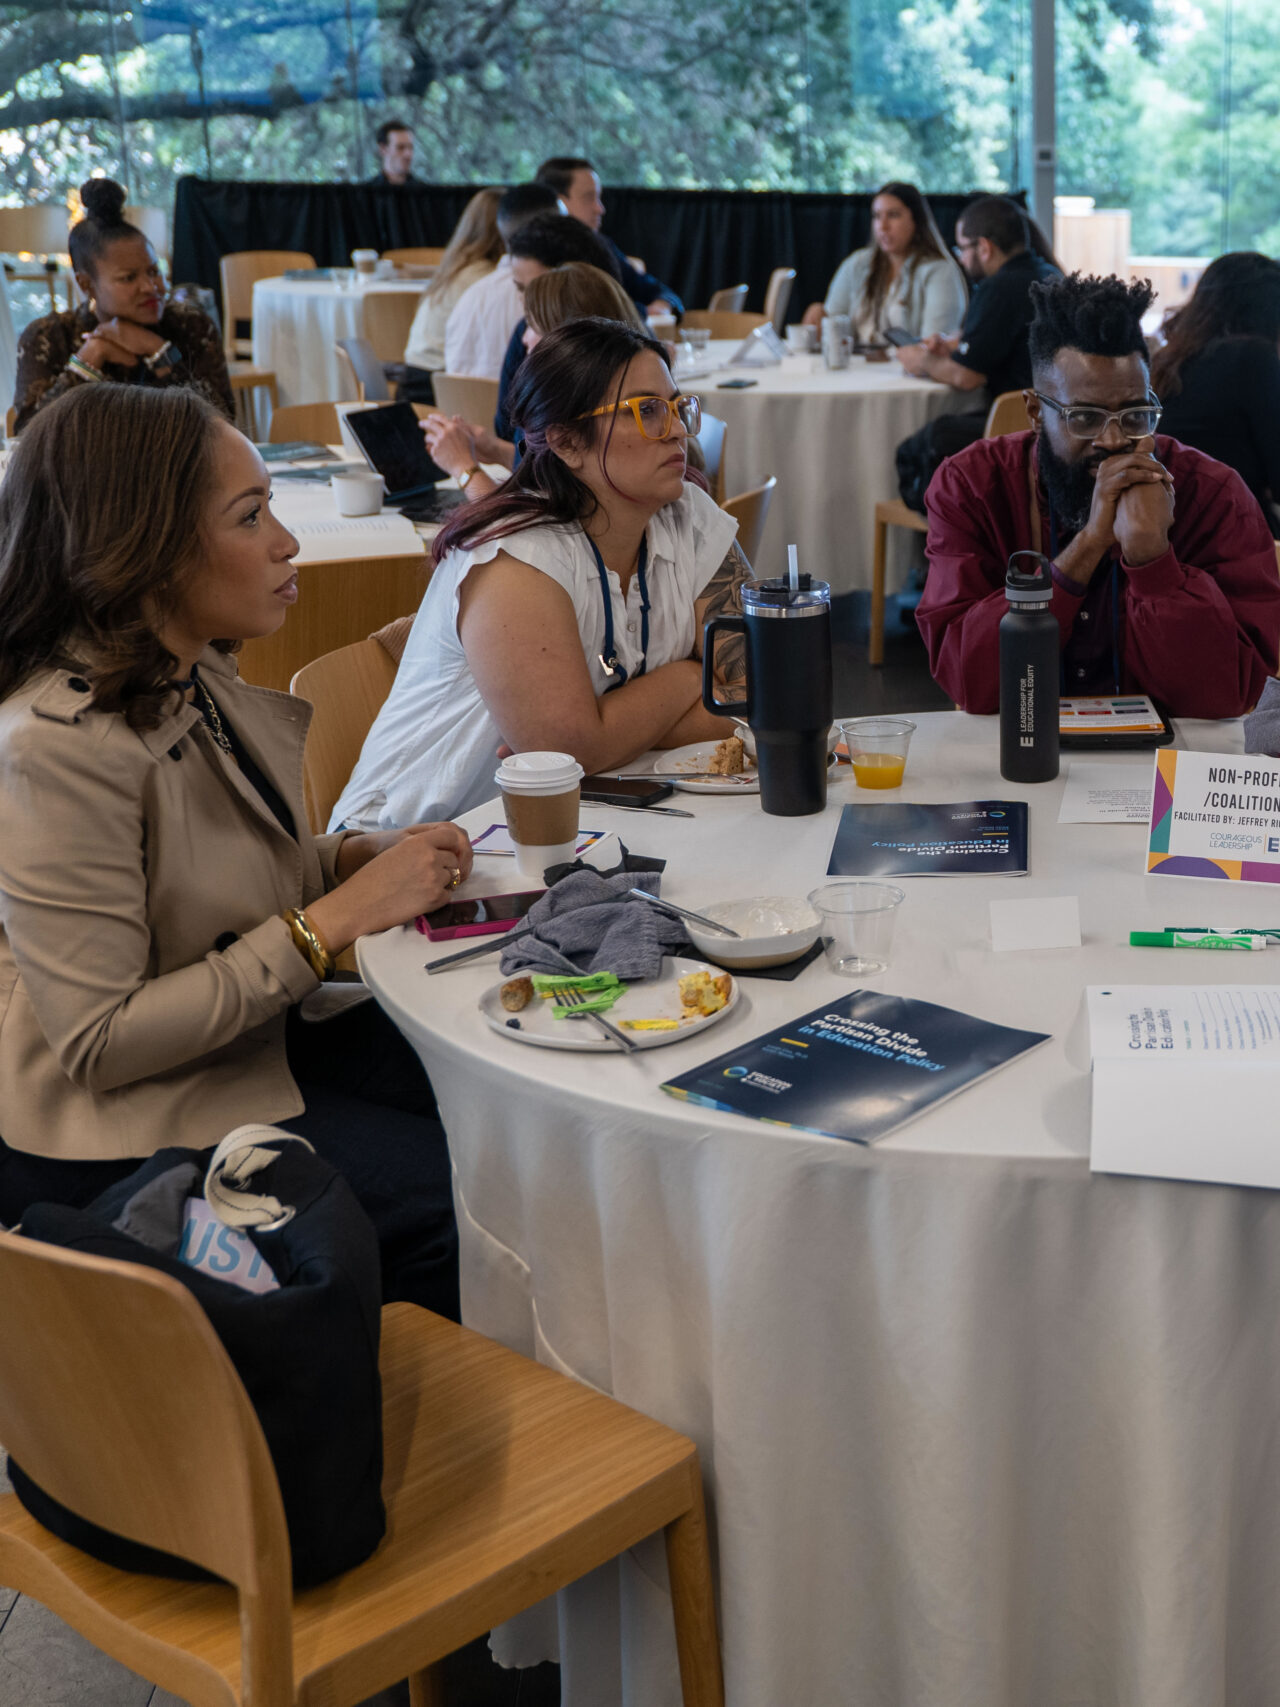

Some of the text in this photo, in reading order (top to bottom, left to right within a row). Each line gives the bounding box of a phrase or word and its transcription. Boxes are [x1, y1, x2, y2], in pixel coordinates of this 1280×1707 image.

[1174, 811, 1221, 824] FACILITATED
[1223, 815, 1235, 825] BY:
[1238, 816, 1269, 827] JEFFREY
[919, 839, 992, 847] Education
[1209, 840, 1253, 851] LEADERSHIP
[1210, 832, 1263, 844] COURAGEOUS
[824, 1013, 920, 1045] Crossing the
[811, 1018, 929, 1059] Partisan Divide
[798, 1024, 815, 1035] in
[815, 1028, 896, 1060] Education
[895, 1053, 946, 1072] Policy
